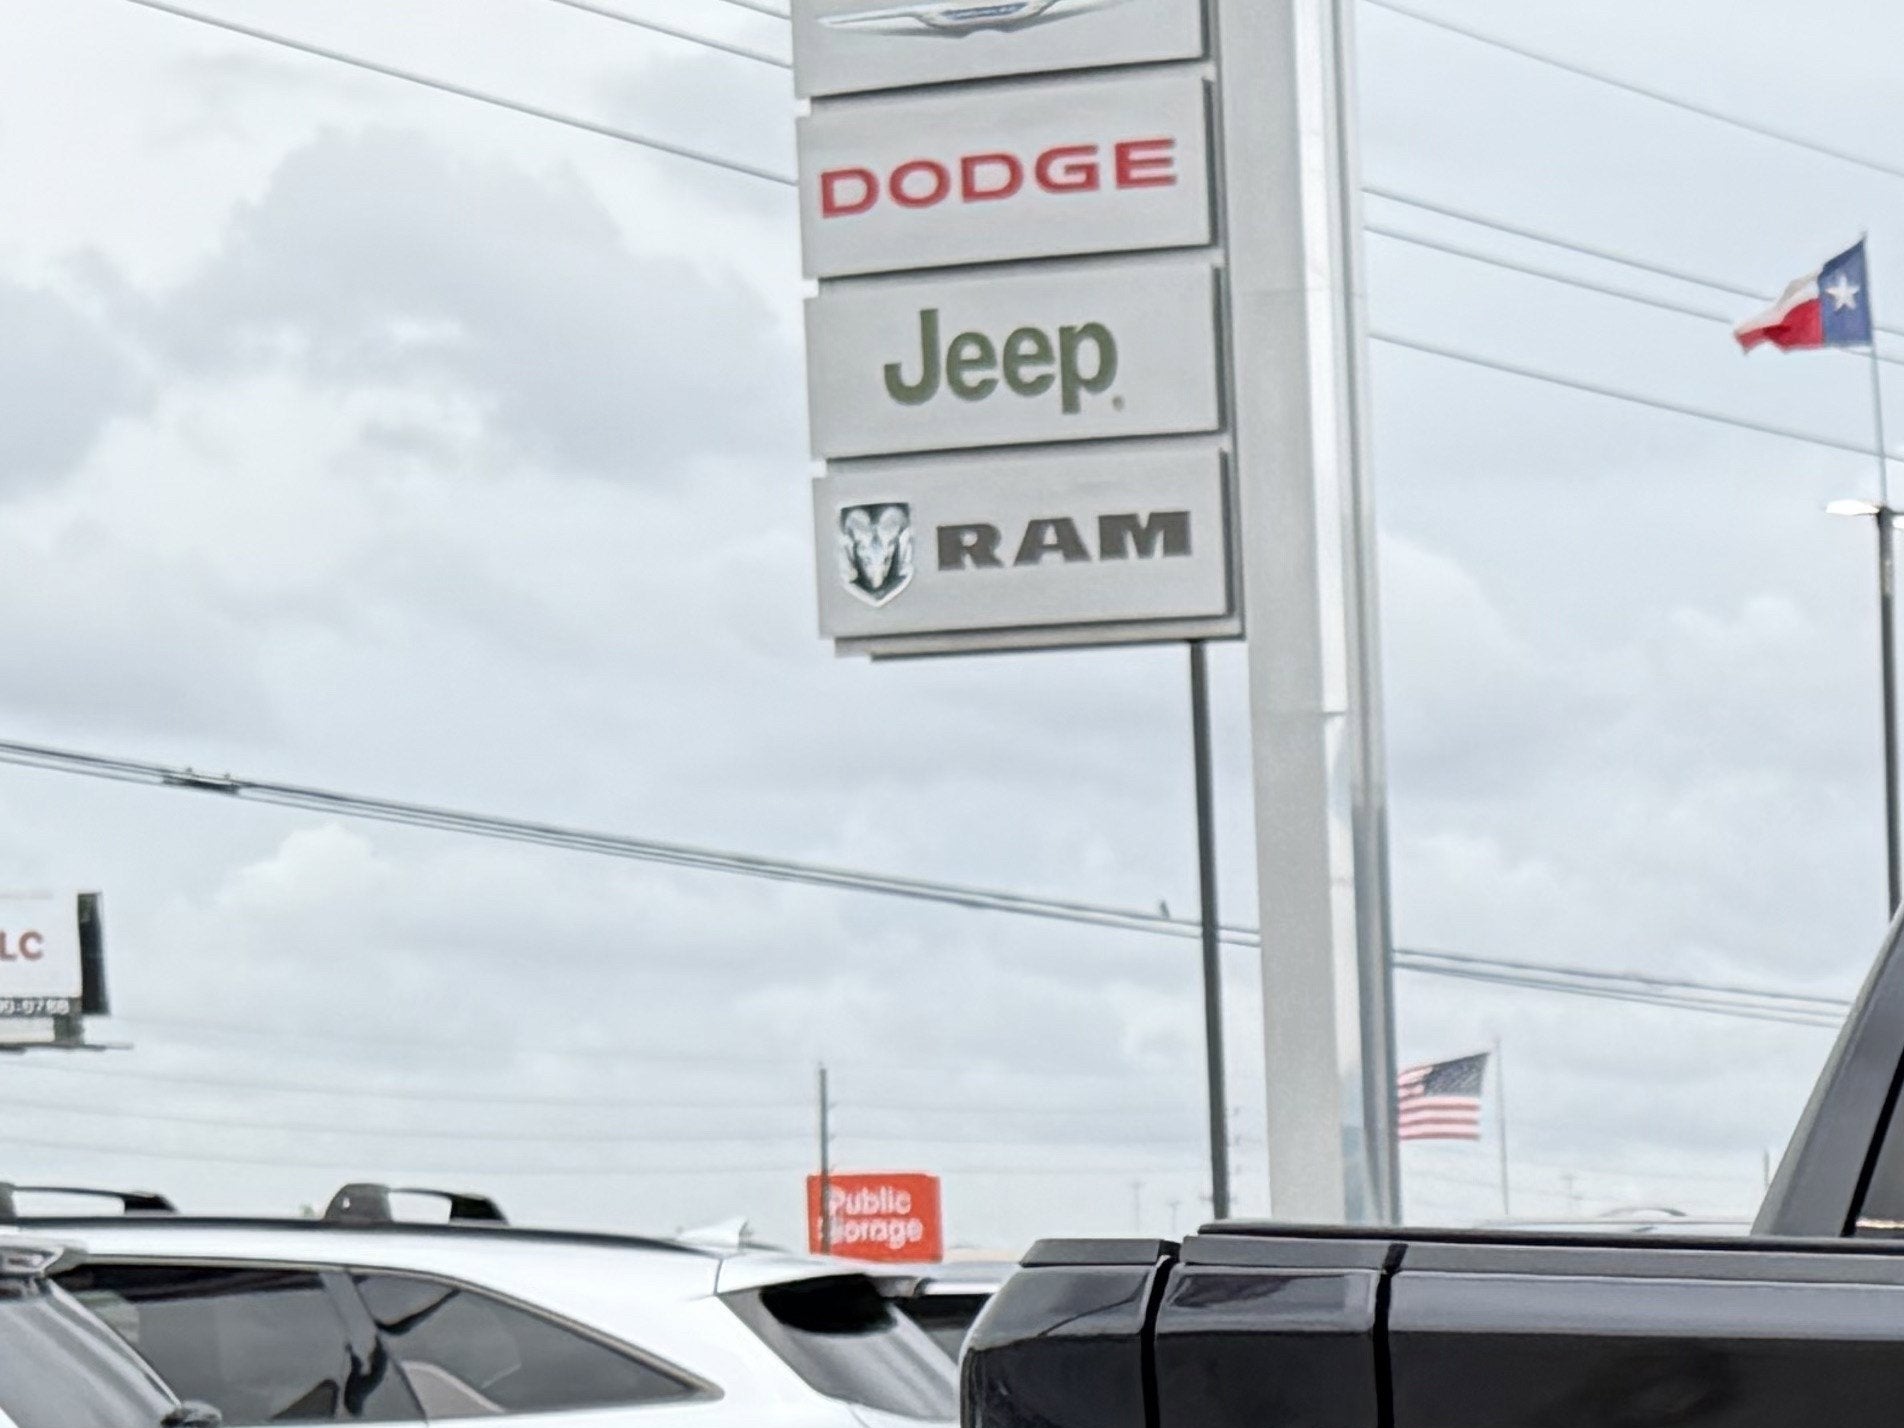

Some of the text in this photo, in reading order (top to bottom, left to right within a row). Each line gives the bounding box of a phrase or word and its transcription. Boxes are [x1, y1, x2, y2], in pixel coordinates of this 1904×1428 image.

[819, 137, 1177, 218] DODGE
[884, 308, 1118, 415] Jeep
[936, 510, 1192, 572] RAM
[826, 1184, 912, 1215] Public
